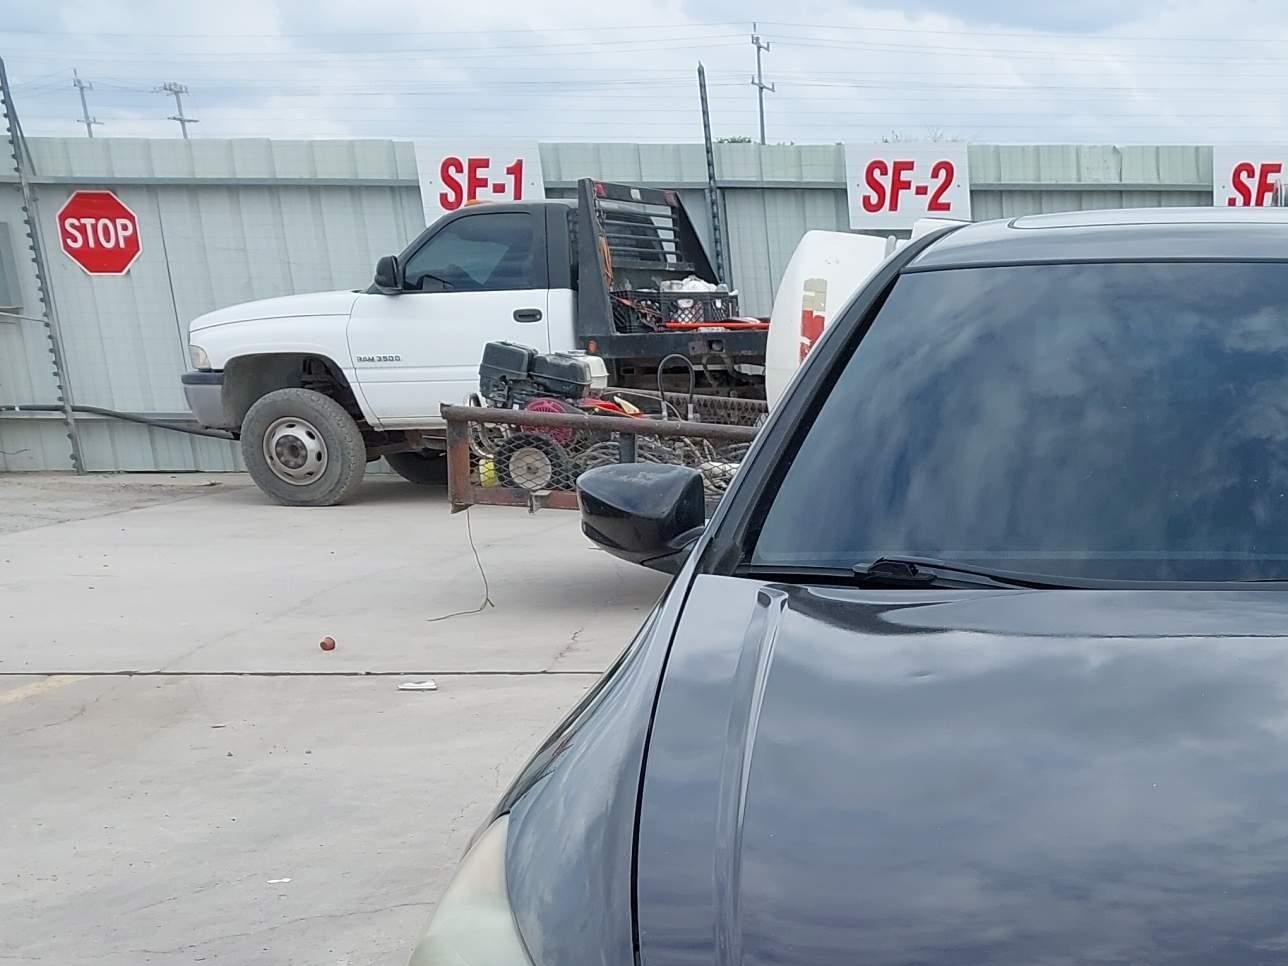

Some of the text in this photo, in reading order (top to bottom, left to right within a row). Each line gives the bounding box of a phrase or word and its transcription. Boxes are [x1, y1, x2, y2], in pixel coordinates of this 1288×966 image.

[439, 157, 524, 211] SF-1
[862, 160, 955, 213] SF-2
[64, 217, 134, 249] STOP
